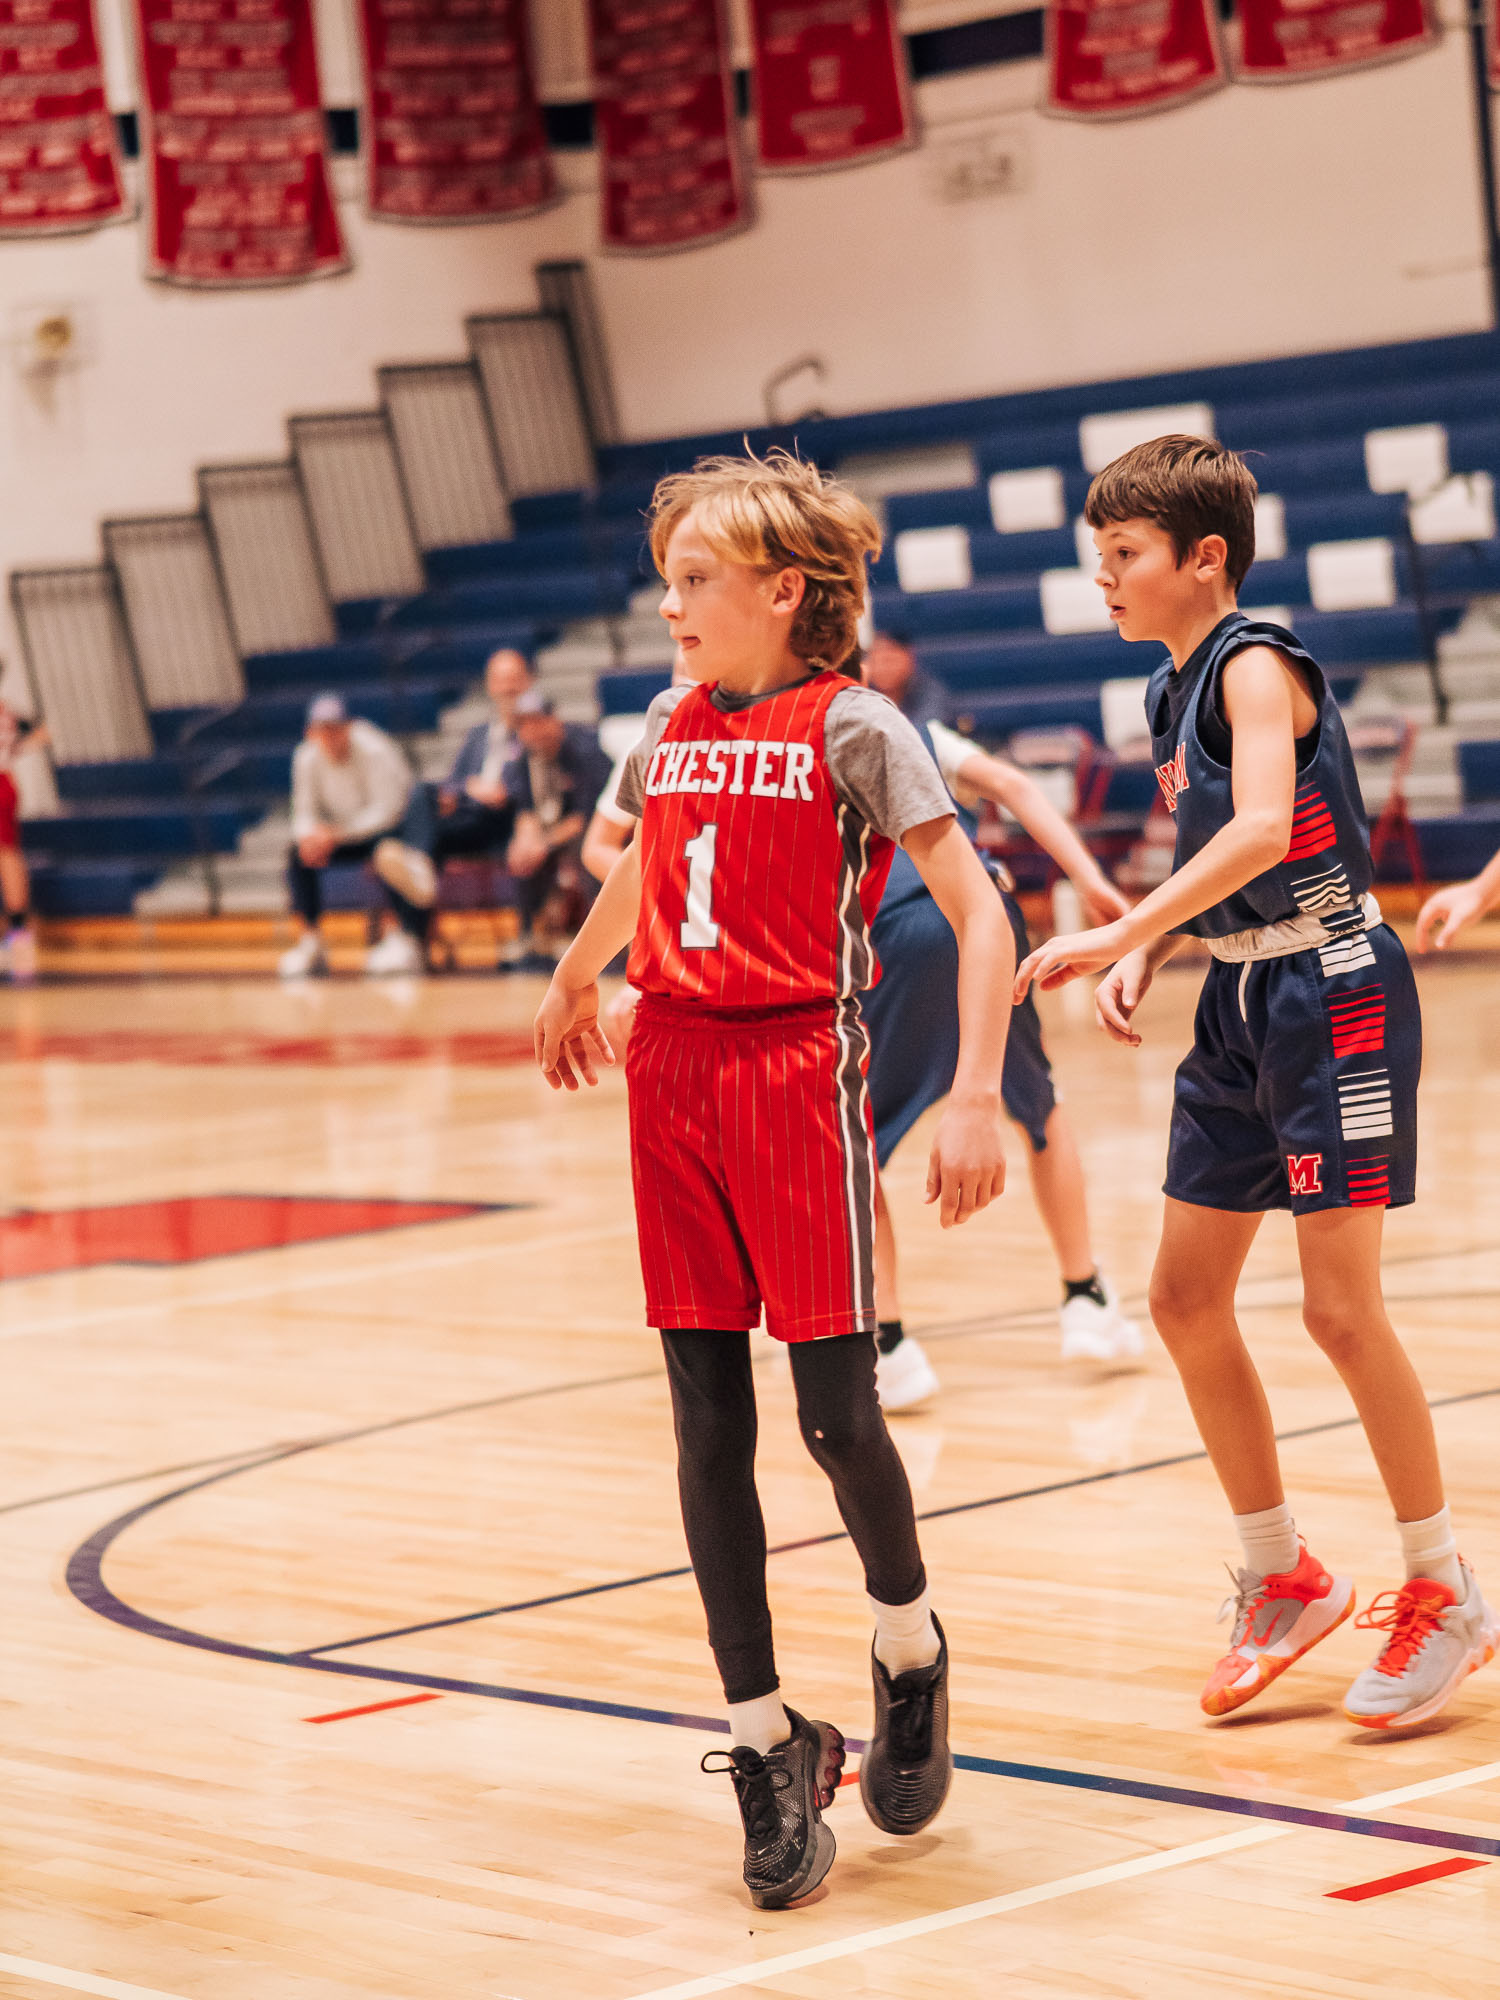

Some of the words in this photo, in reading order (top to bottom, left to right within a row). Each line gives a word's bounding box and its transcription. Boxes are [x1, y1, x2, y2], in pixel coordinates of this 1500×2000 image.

[645, 740, 814, 802] CHESTER
[680, 822, 720, 951] 1
[1286, 1152, 1323, 1195] M
